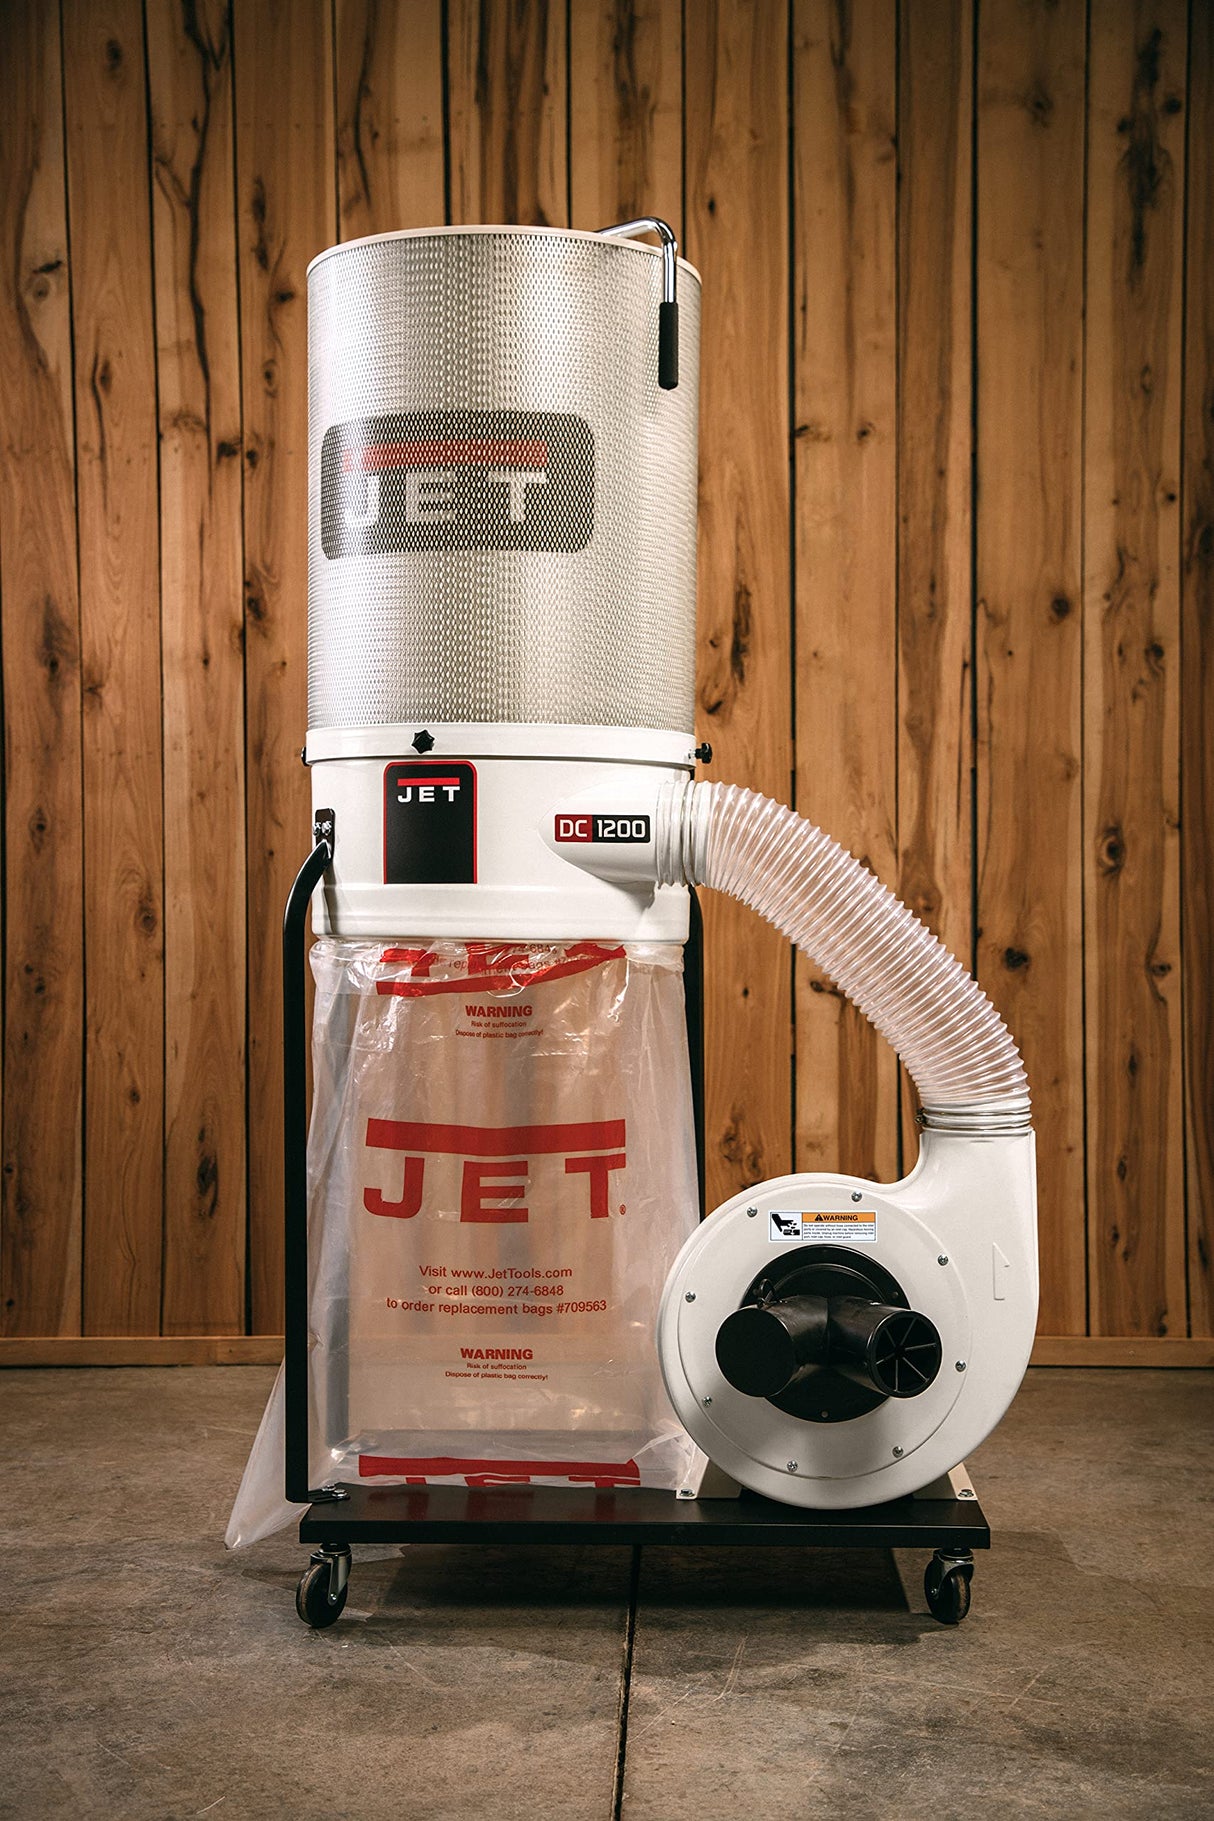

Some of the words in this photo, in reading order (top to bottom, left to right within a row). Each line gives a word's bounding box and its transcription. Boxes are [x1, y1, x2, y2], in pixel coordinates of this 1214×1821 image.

[343, 471, 548, 527] JET
[397, 786, 460, 803] JET
[559, 819, 588, 838] DC
[597, 819, 646, 838] 1200
[465, 1005, 533, 1018] WARNING
[471, 1020, 483, 1028] Risk
[484, 1020, 491, 1028] of
[492, 1020, 527, 1029] suffocation
[455, 1029, 475, 1038] Dispose
[505, 1031, 517, 1039] bag
[363, 1153, 626, 1223] JET
[419, 1265, 447, 1278] Visit
[451, 1267, 573, 1279] www.JetTools.com
[428, 1285, 442, 1295] or
[445, 1284, 468, 1296] call
[471, 1285, 504, 1298] (800)
[507, 1285, 564, 1297] 274-6848
[386, 1297, 398, 1309] to
[402, 1301, 435, 1312] order
[438, 1303, 518, 1316] replacement
[522, 1303, 553, 1316] bags
[556, 1300, 607, 1314] #709563
[460, 1348, 533, 1361] WARNING
[490, 1363, 527, 1371] suffocation
[445, 1371, 471, 1379] Dispose
[480, 1372, 503, 1380] plastic
[504, 1372, 516, 1380] bag
